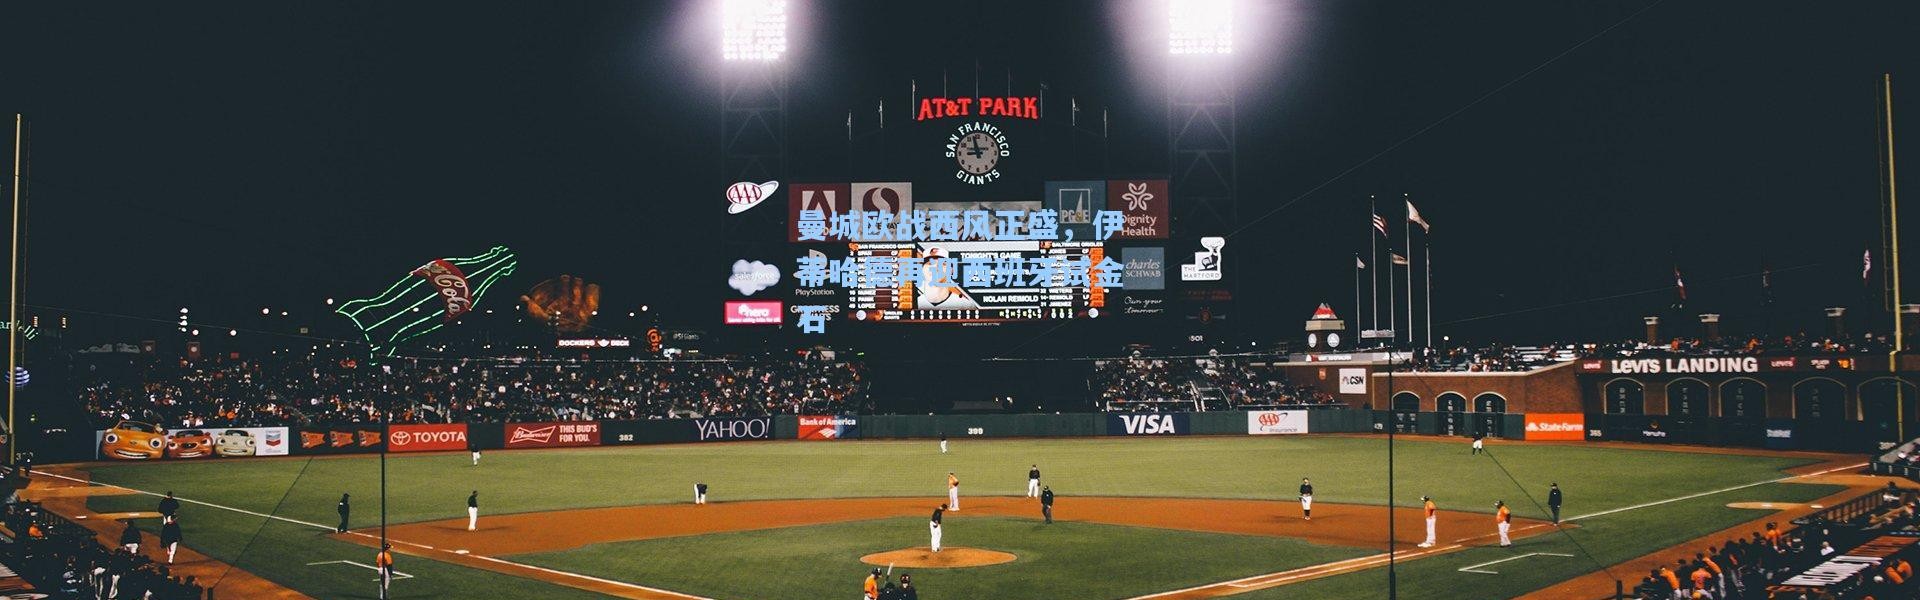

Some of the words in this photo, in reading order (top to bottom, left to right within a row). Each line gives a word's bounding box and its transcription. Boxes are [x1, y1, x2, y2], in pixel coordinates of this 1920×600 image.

[918, 97, 972, 120] AT&T
[979, 96, 1038, 120] PARK
[945, 134, 960, 158] SAN
[958, 121, 1010, 157] FRANCISCO
[956, 168, 1001, 185] GIANTS
[1061, 209, 1089, 222] PG&E
[1121, 226, 1156, 236] Health
[1125, 258, 1161, 270] charles
[1125, 269, 1162, 279] SCHWAB
[795, 288, 835, 297] PlayStation
[983, 295, 1007, 303] NOLAN
[1008, 295, 1039, 303] REIMOLD
[1144, 299, 1163, 309] your
[1665, 357, 1758, 373] LANDING
[1350, 376, 1364, 385] CSN
[559, 425, 575, 433] THIS
[576, 424, 598, 433] BUD'S
[695, 418, 770, 441] YAHOO!
[1119, 414, 1175, 434] VISA
[413, 431, 467, 443] TOYOTA
[514, 430, 551, 439] Budweiser
[559, 434, 573, 442] FOR
[574, 434, 590, 442] YOU.
